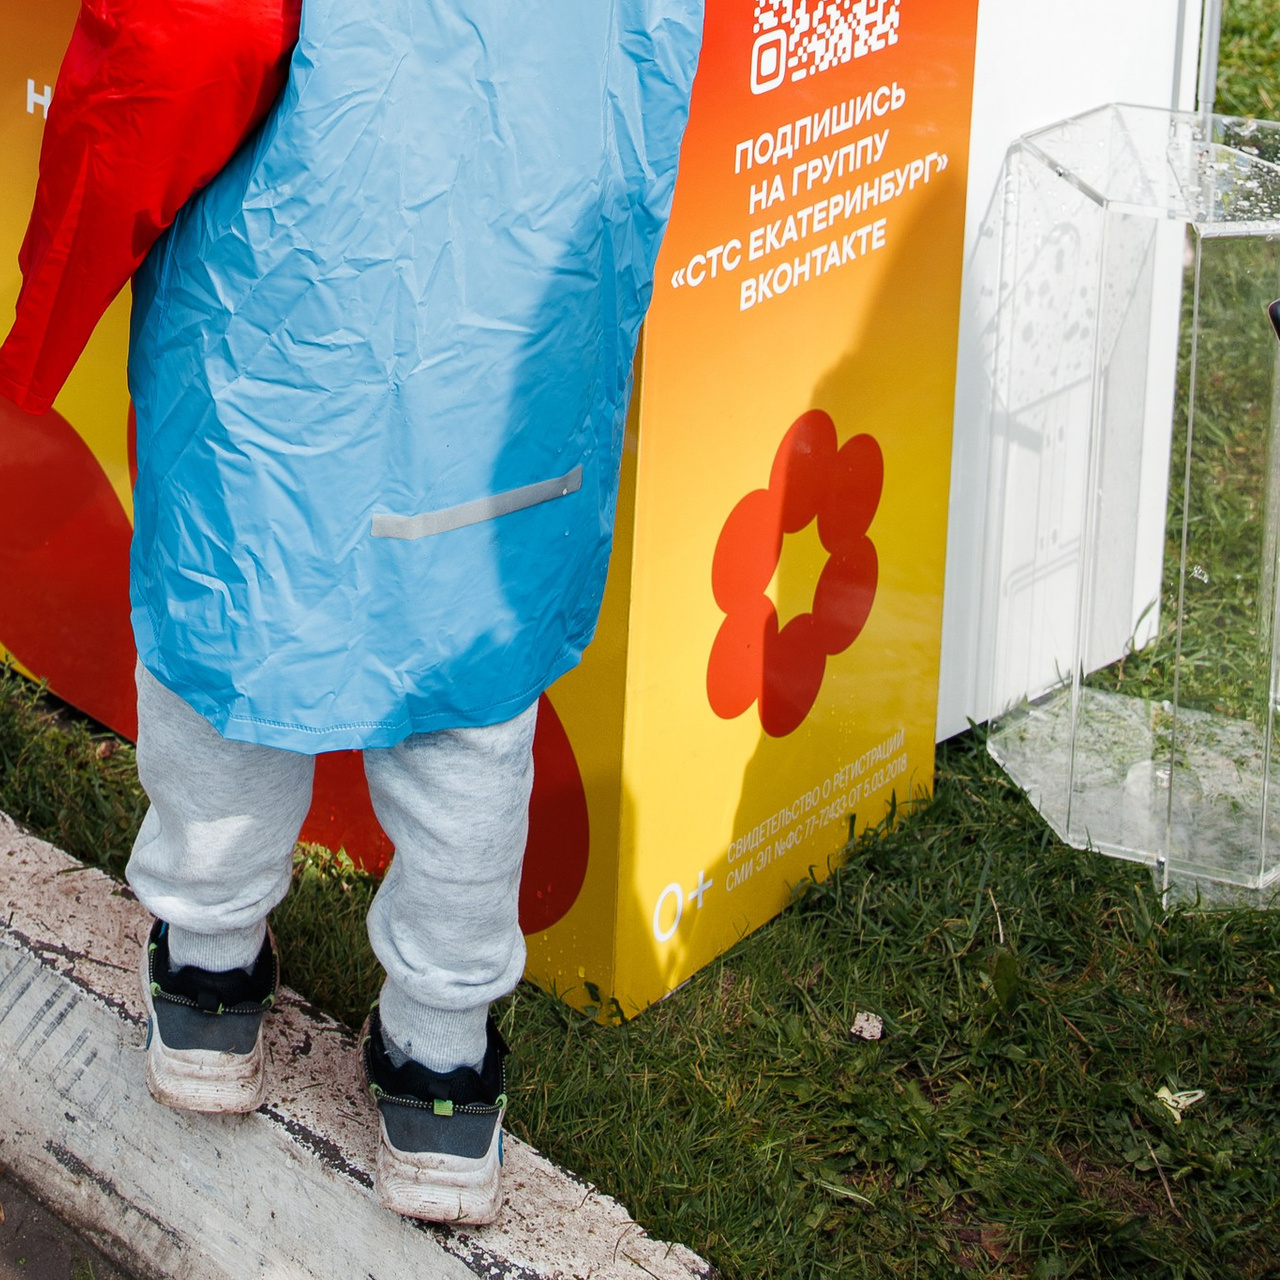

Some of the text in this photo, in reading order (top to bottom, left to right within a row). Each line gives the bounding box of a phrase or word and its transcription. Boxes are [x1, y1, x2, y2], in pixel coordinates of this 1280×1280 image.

[734, 82, 906, 174] ПОДПИШИСЬ
[749, 129, 889, 214] НА ГРУППУ
[671, 152, 948, 289] «СТС ЕКАТЕРИНБУРГ»
[740, 218, 887, 311] ВКОНТАКТЕ
[725, 859, 754, 892] СМИ
[756, 845, 772, 872] ЭЛ
[848, 784, 862, 808] ОТ
[863, 752, 907, 798] 5.03.2018
[727, 728, 905, 863] СВИДЕТЕЛЬСТВО О РЕГИСТРАЦИИ
[652, 869, 714, 943] 0+
